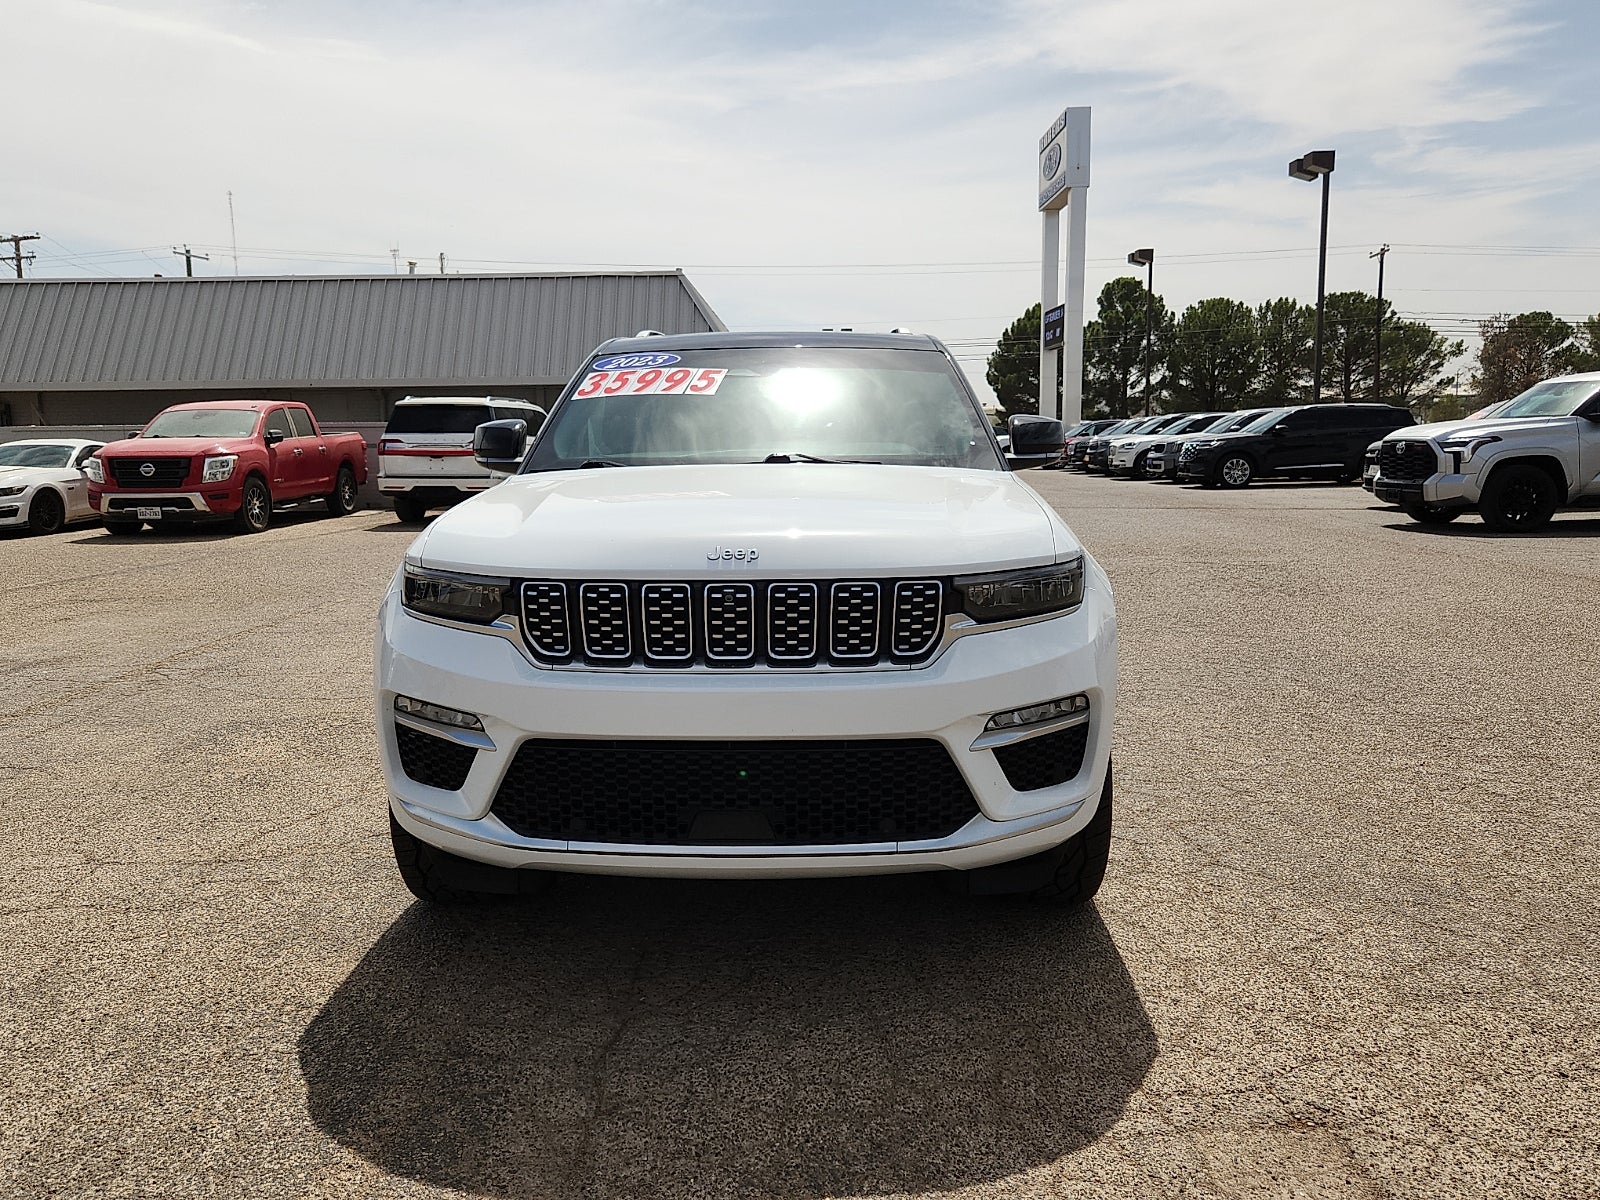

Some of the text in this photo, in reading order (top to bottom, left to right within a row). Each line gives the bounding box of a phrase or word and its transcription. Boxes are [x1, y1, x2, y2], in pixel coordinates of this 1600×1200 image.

[608, 354, 669, 369] 2023
[577, 368, 725, 397] 35995
[706, 545, 759, 563] Jeep
